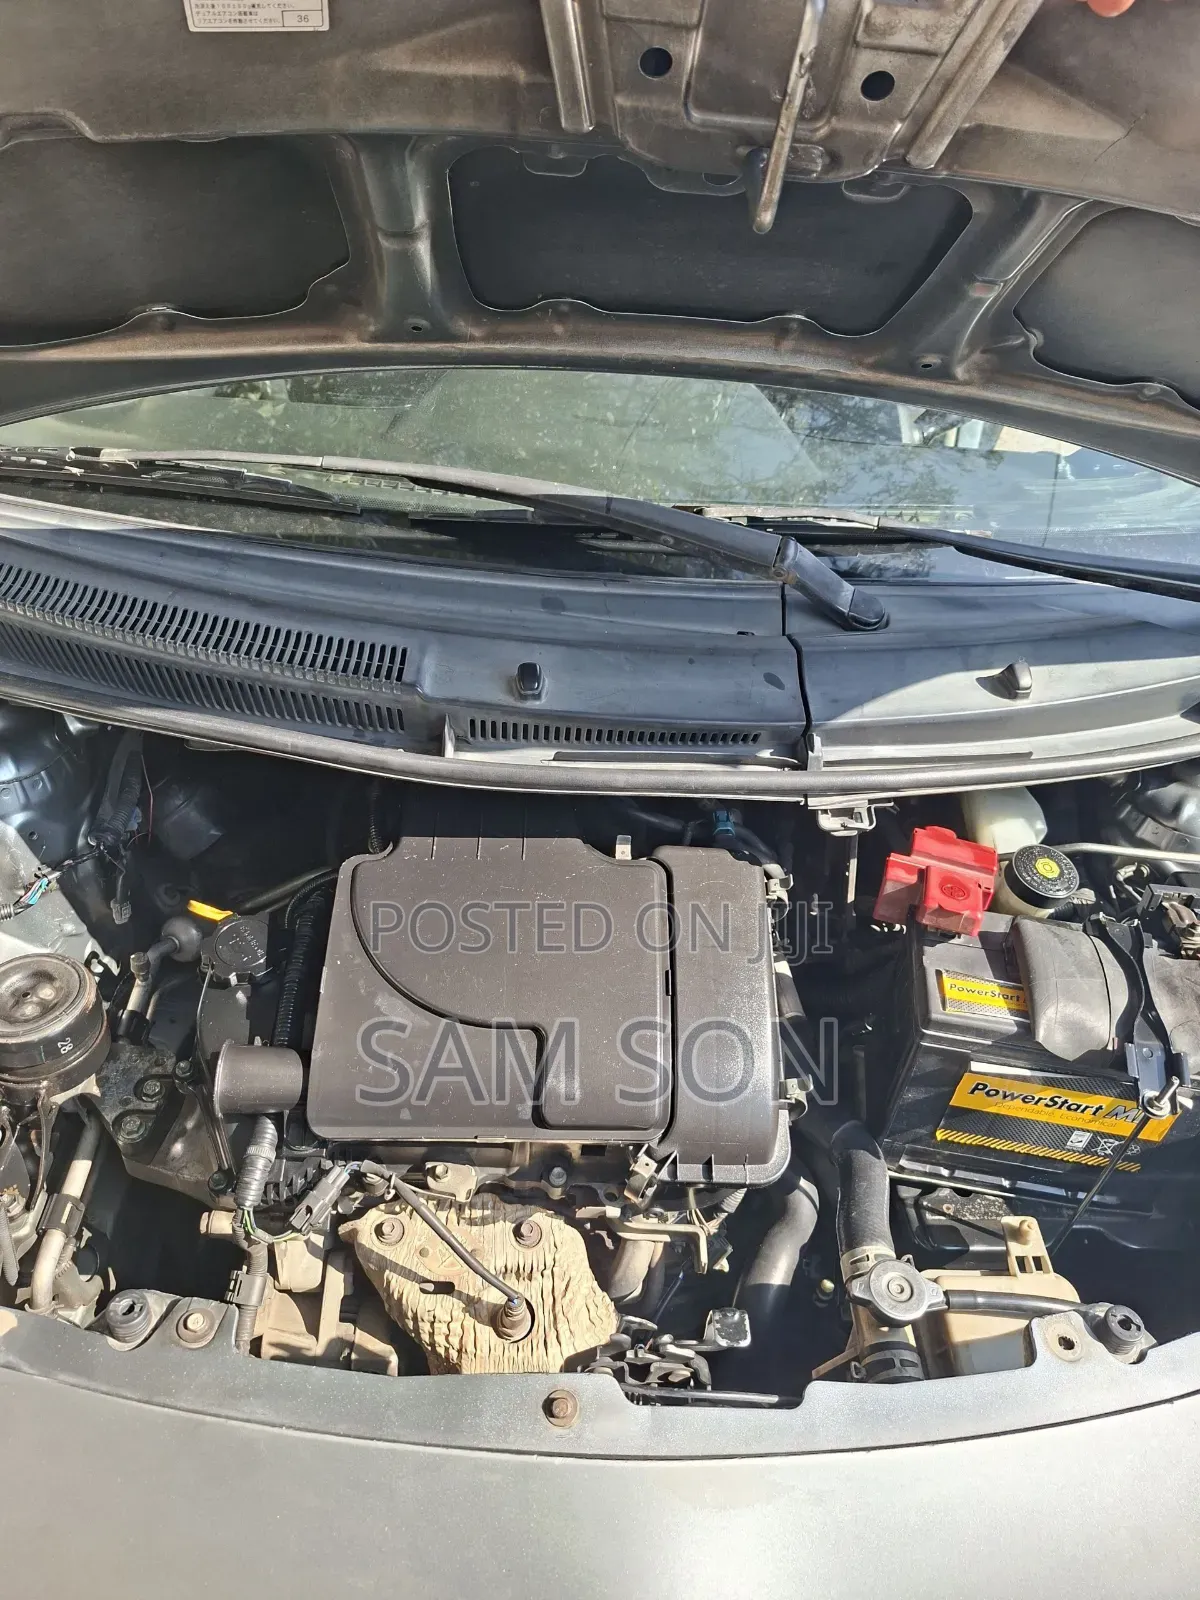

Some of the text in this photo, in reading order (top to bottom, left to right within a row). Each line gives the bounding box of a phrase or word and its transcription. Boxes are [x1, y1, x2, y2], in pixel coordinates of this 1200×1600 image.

[296, 14, 310, 23] 36
[949, 983, 1021, 1002] PowerStart
[967, 1081, 1105, 1117] PowerStart
[994, 1101, 1117, 1129] Dependable, Economical
